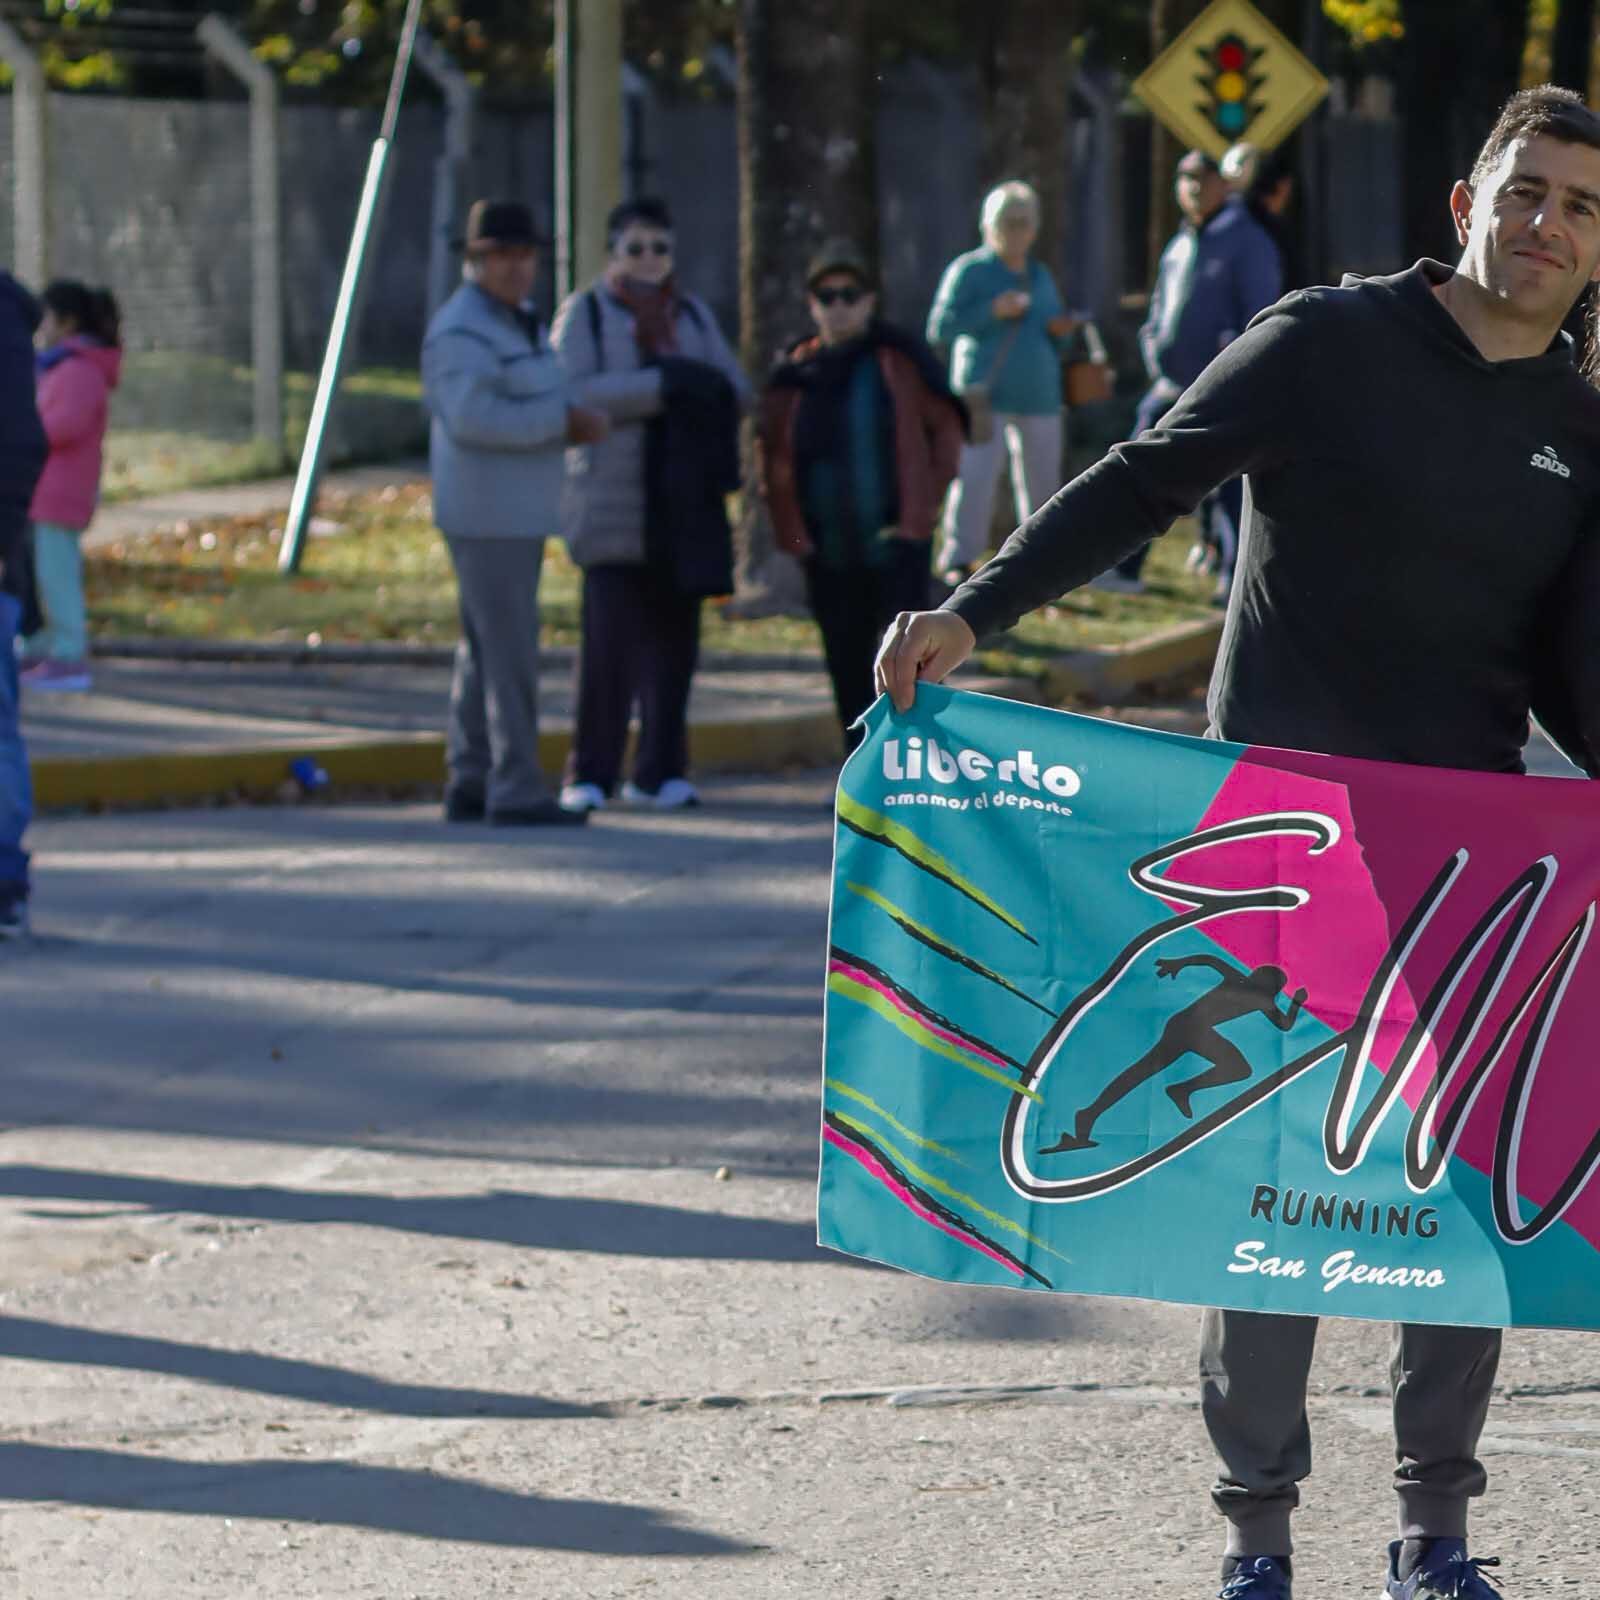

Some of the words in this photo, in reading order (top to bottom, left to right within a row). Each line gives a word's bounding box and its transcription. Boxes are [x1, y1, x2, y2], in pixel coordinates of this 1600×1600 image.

[883, 736, 1081, 797] Liberto
[883, 792, 969, 811] amamos
[974, 791, 988, 809] el
[992, 790, 1073, 817] deporte
[1250, 1184, 1439, 1238] RUNNING
[1226, 1240, 1307, 1279] San
[1321, 1250, 1446, 1293] Genaro
